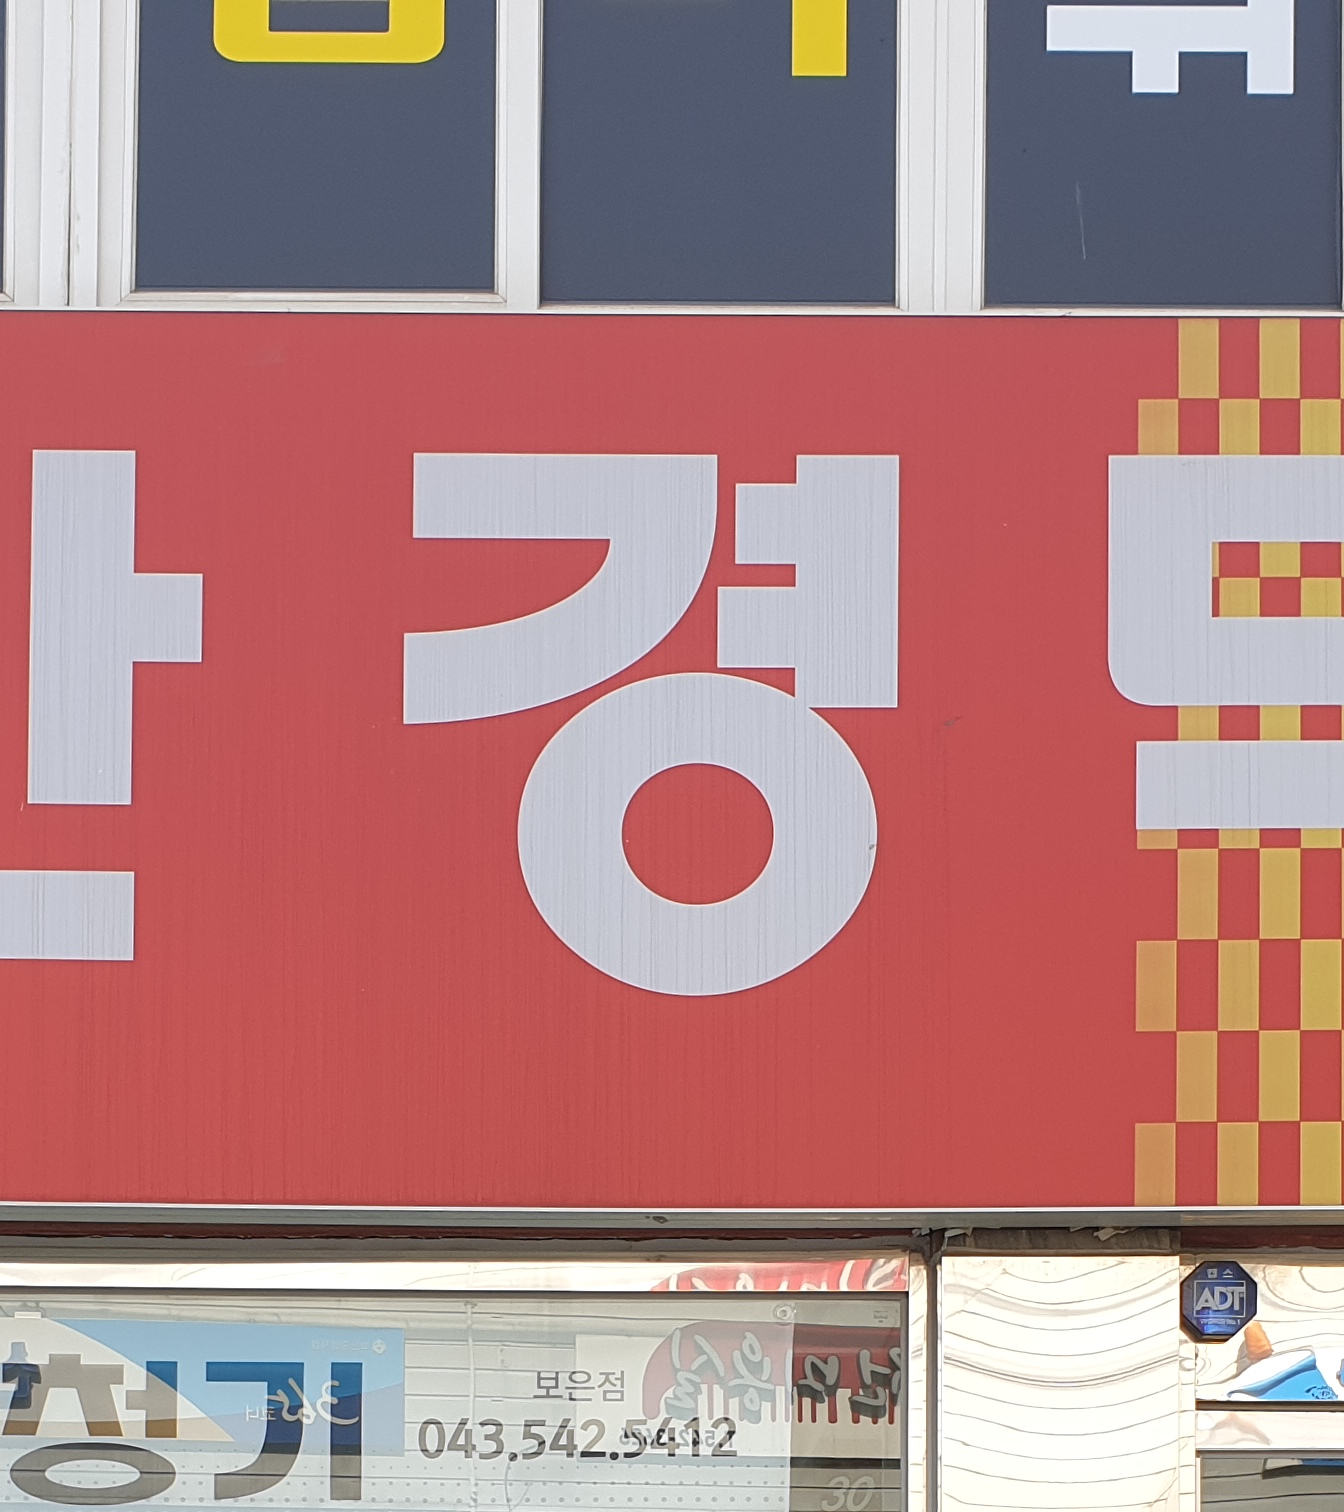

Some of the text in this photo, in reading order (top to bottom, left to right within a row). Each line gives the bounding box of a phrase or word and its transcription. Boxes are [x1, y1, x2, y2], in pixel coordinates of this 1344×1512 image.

[1195, 1286, 1245, 1311] ADT
[532, 1369, 627, 1404] 보은점
[418, 1416, 739, 1462] 043.542.5412
